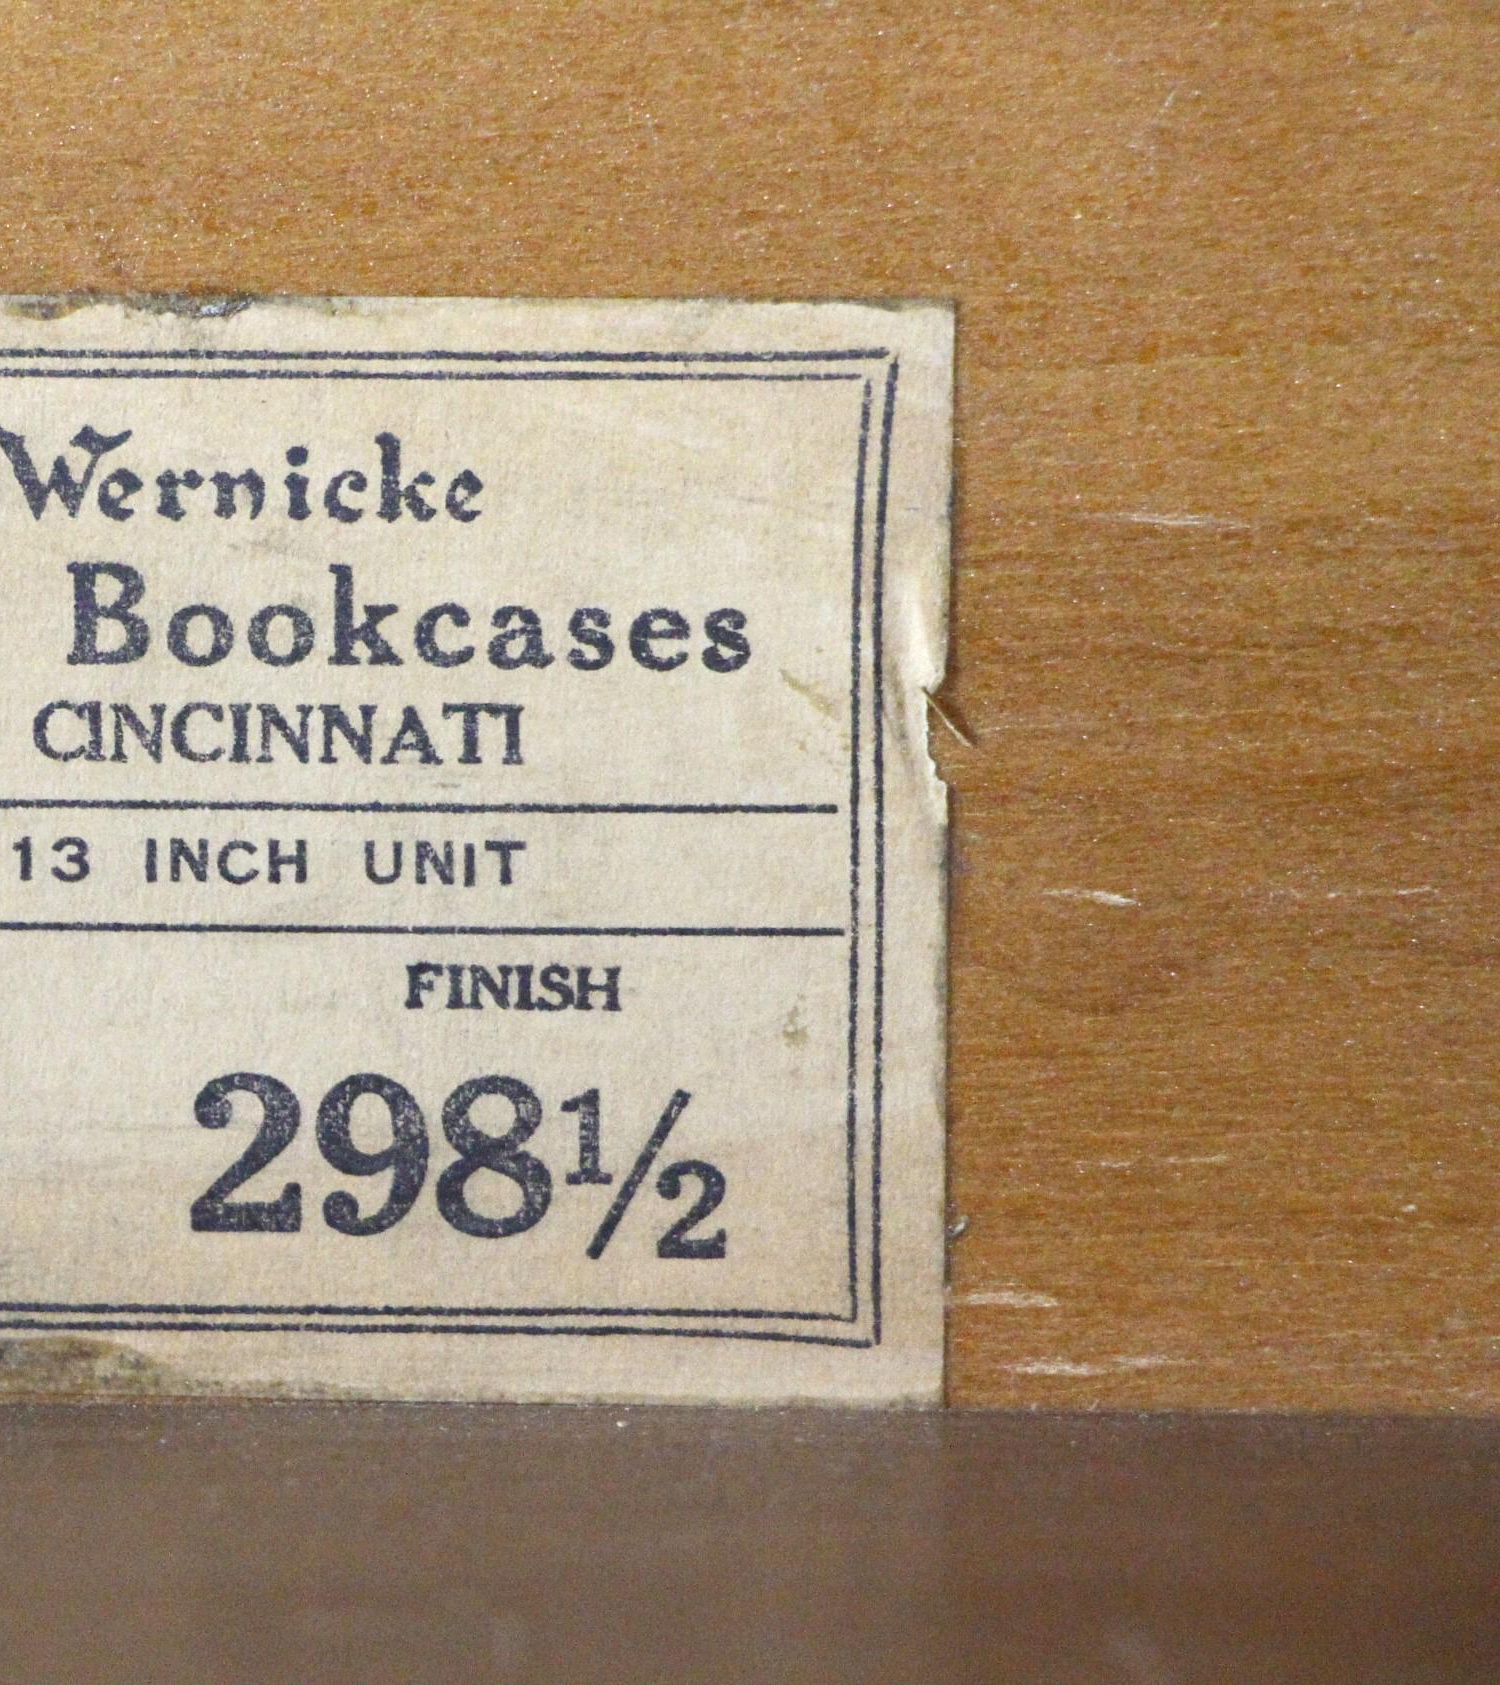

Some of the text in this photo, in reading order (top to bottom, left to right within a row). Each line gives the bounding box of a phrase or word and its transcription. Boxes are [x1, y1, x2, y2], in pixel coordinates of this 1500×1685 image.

[65, 560, 752, 674] Bookcases
[33, 699, 526, 766] CINCINNATI
[12, 836, 90, 883] 13
[145, 837, 308, 885] INCH
[364, 839, 527, 889] UNIT
[404, 961, 623, 1012] FINISH
